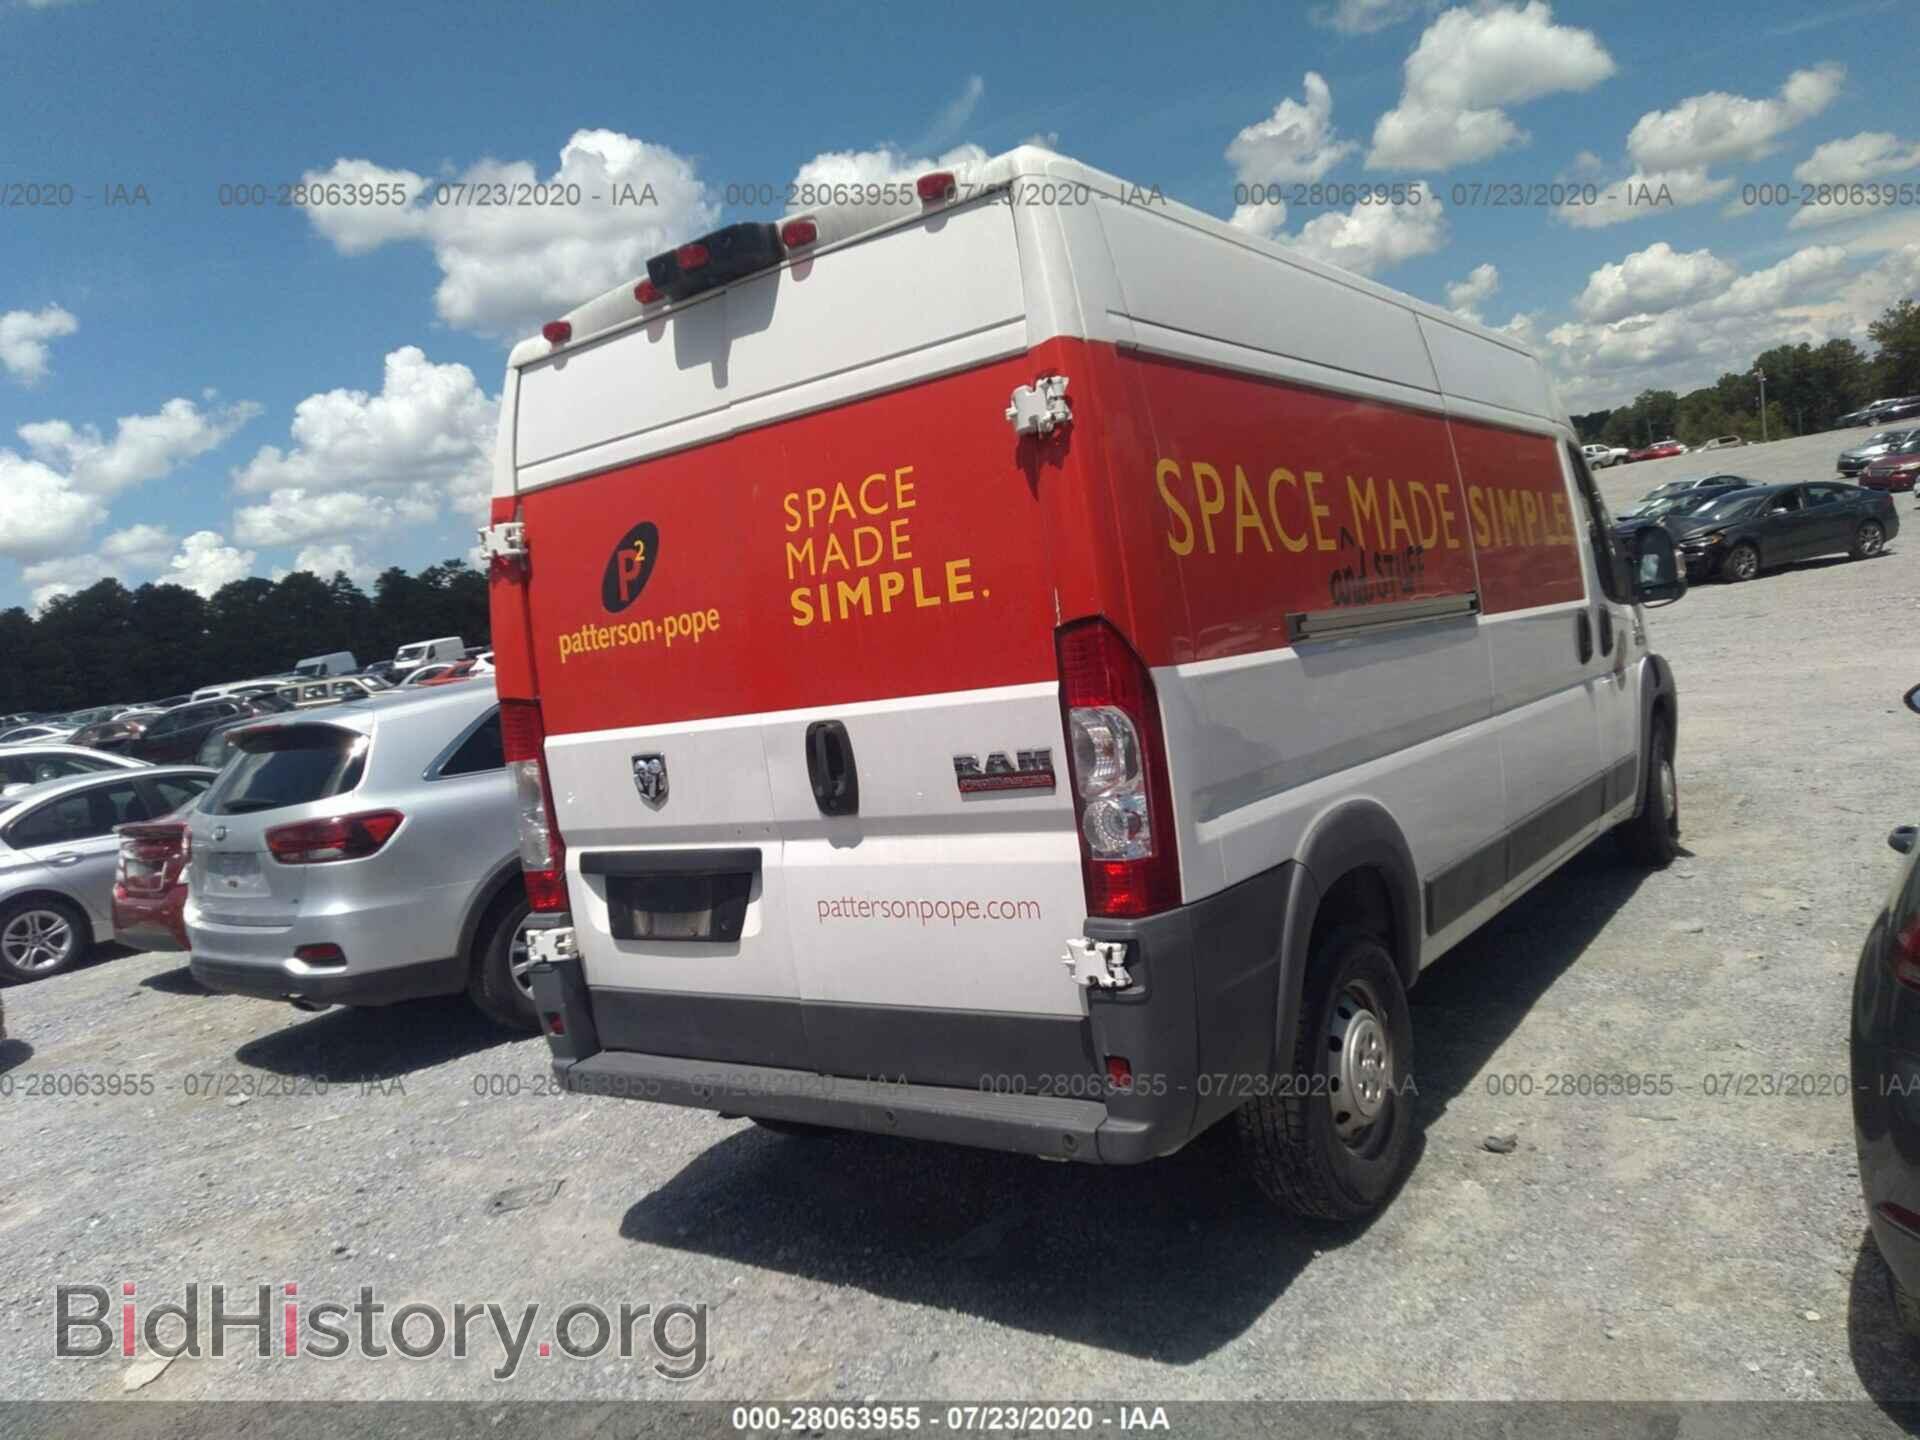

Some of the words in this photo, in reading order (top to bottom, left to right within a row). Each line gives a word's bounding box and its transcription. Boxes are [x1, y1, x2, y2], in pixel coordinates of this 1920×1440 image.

[783, 465, 916, 532] SPACE
[1156, 458, 1336, 556] SPACE
[1346, 475, 1459, 551] MADE
[785, 517, 913, 580] MADE
[790, 558, 990, 626] SIMPLE.
[953, 748, 1054, 776] RAM
[816, 896, 1041, 926] pattersonpope.com
